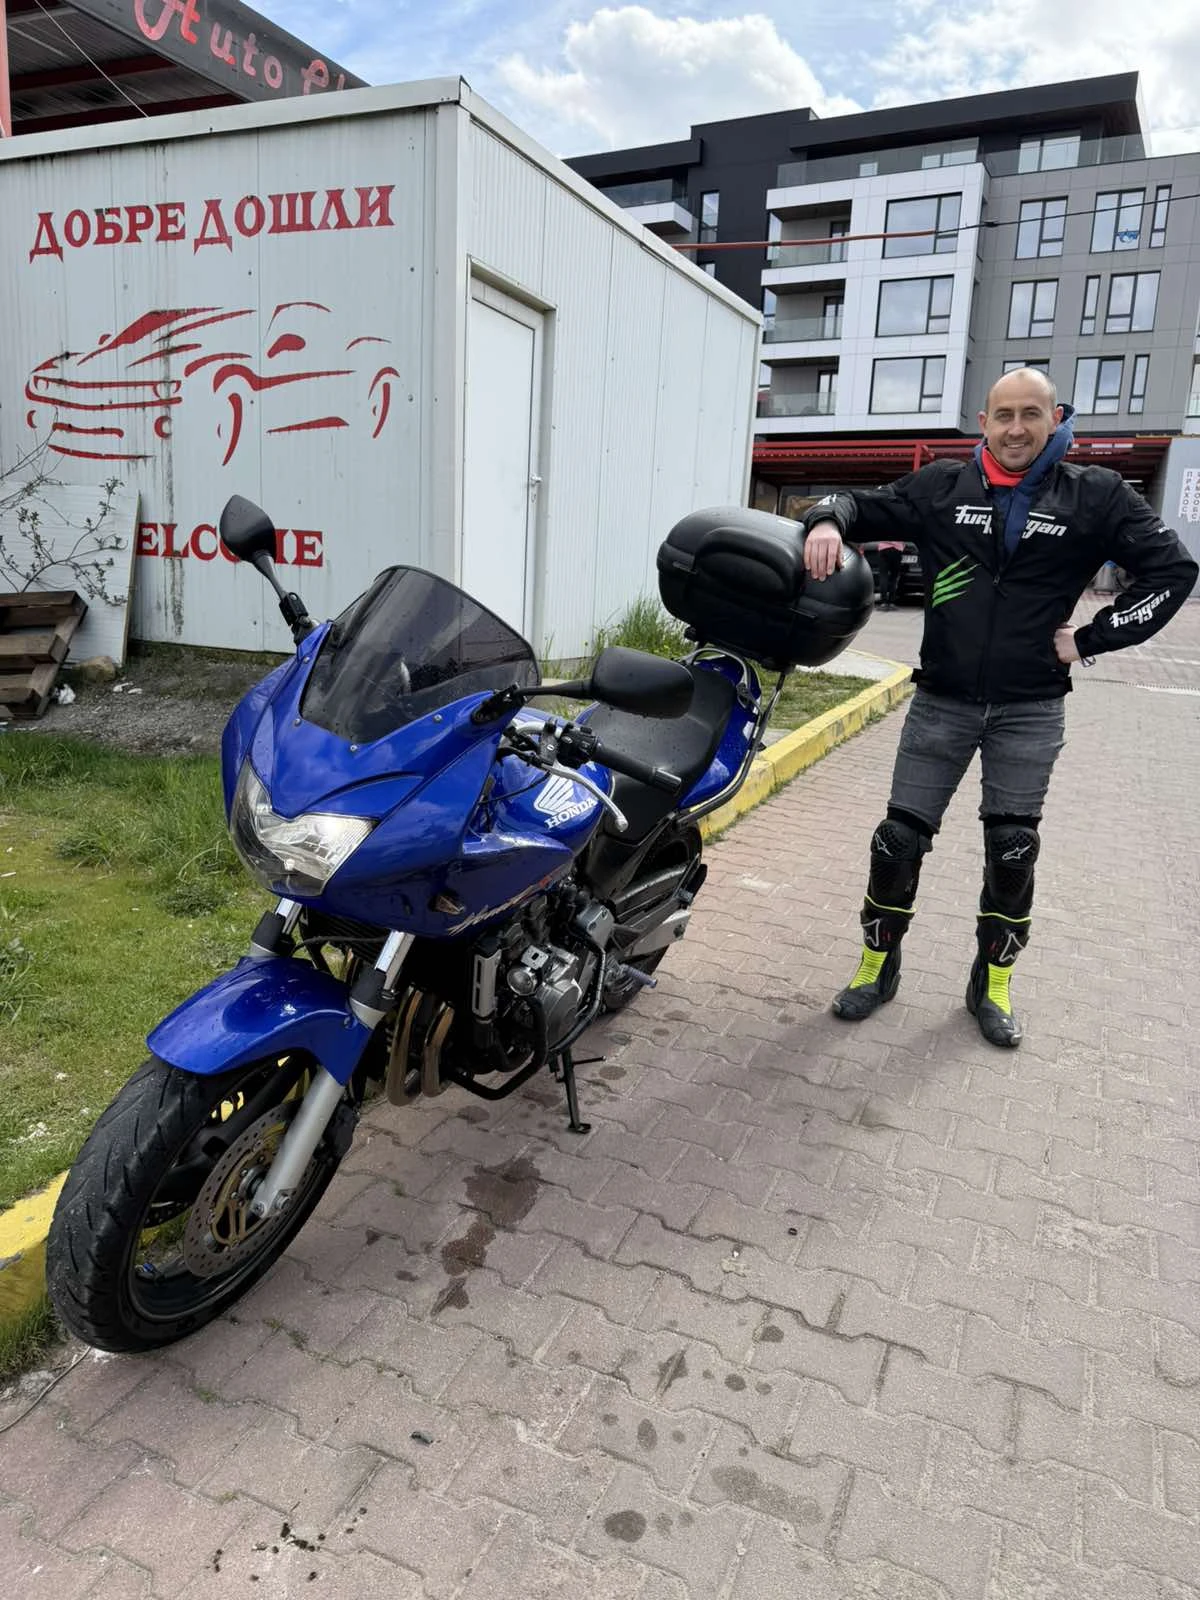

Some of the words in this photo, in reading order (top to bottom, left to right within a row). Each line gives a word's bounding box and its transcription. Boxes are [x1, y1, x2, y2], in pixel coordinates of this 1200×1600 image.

[29, 201, 186, 264] ДОБРЕ
[193, 184, 396, 256] ДОШЛИ
[136, 522, 323, 567] ELCE
[544, 799, 598, 828] HONDA
